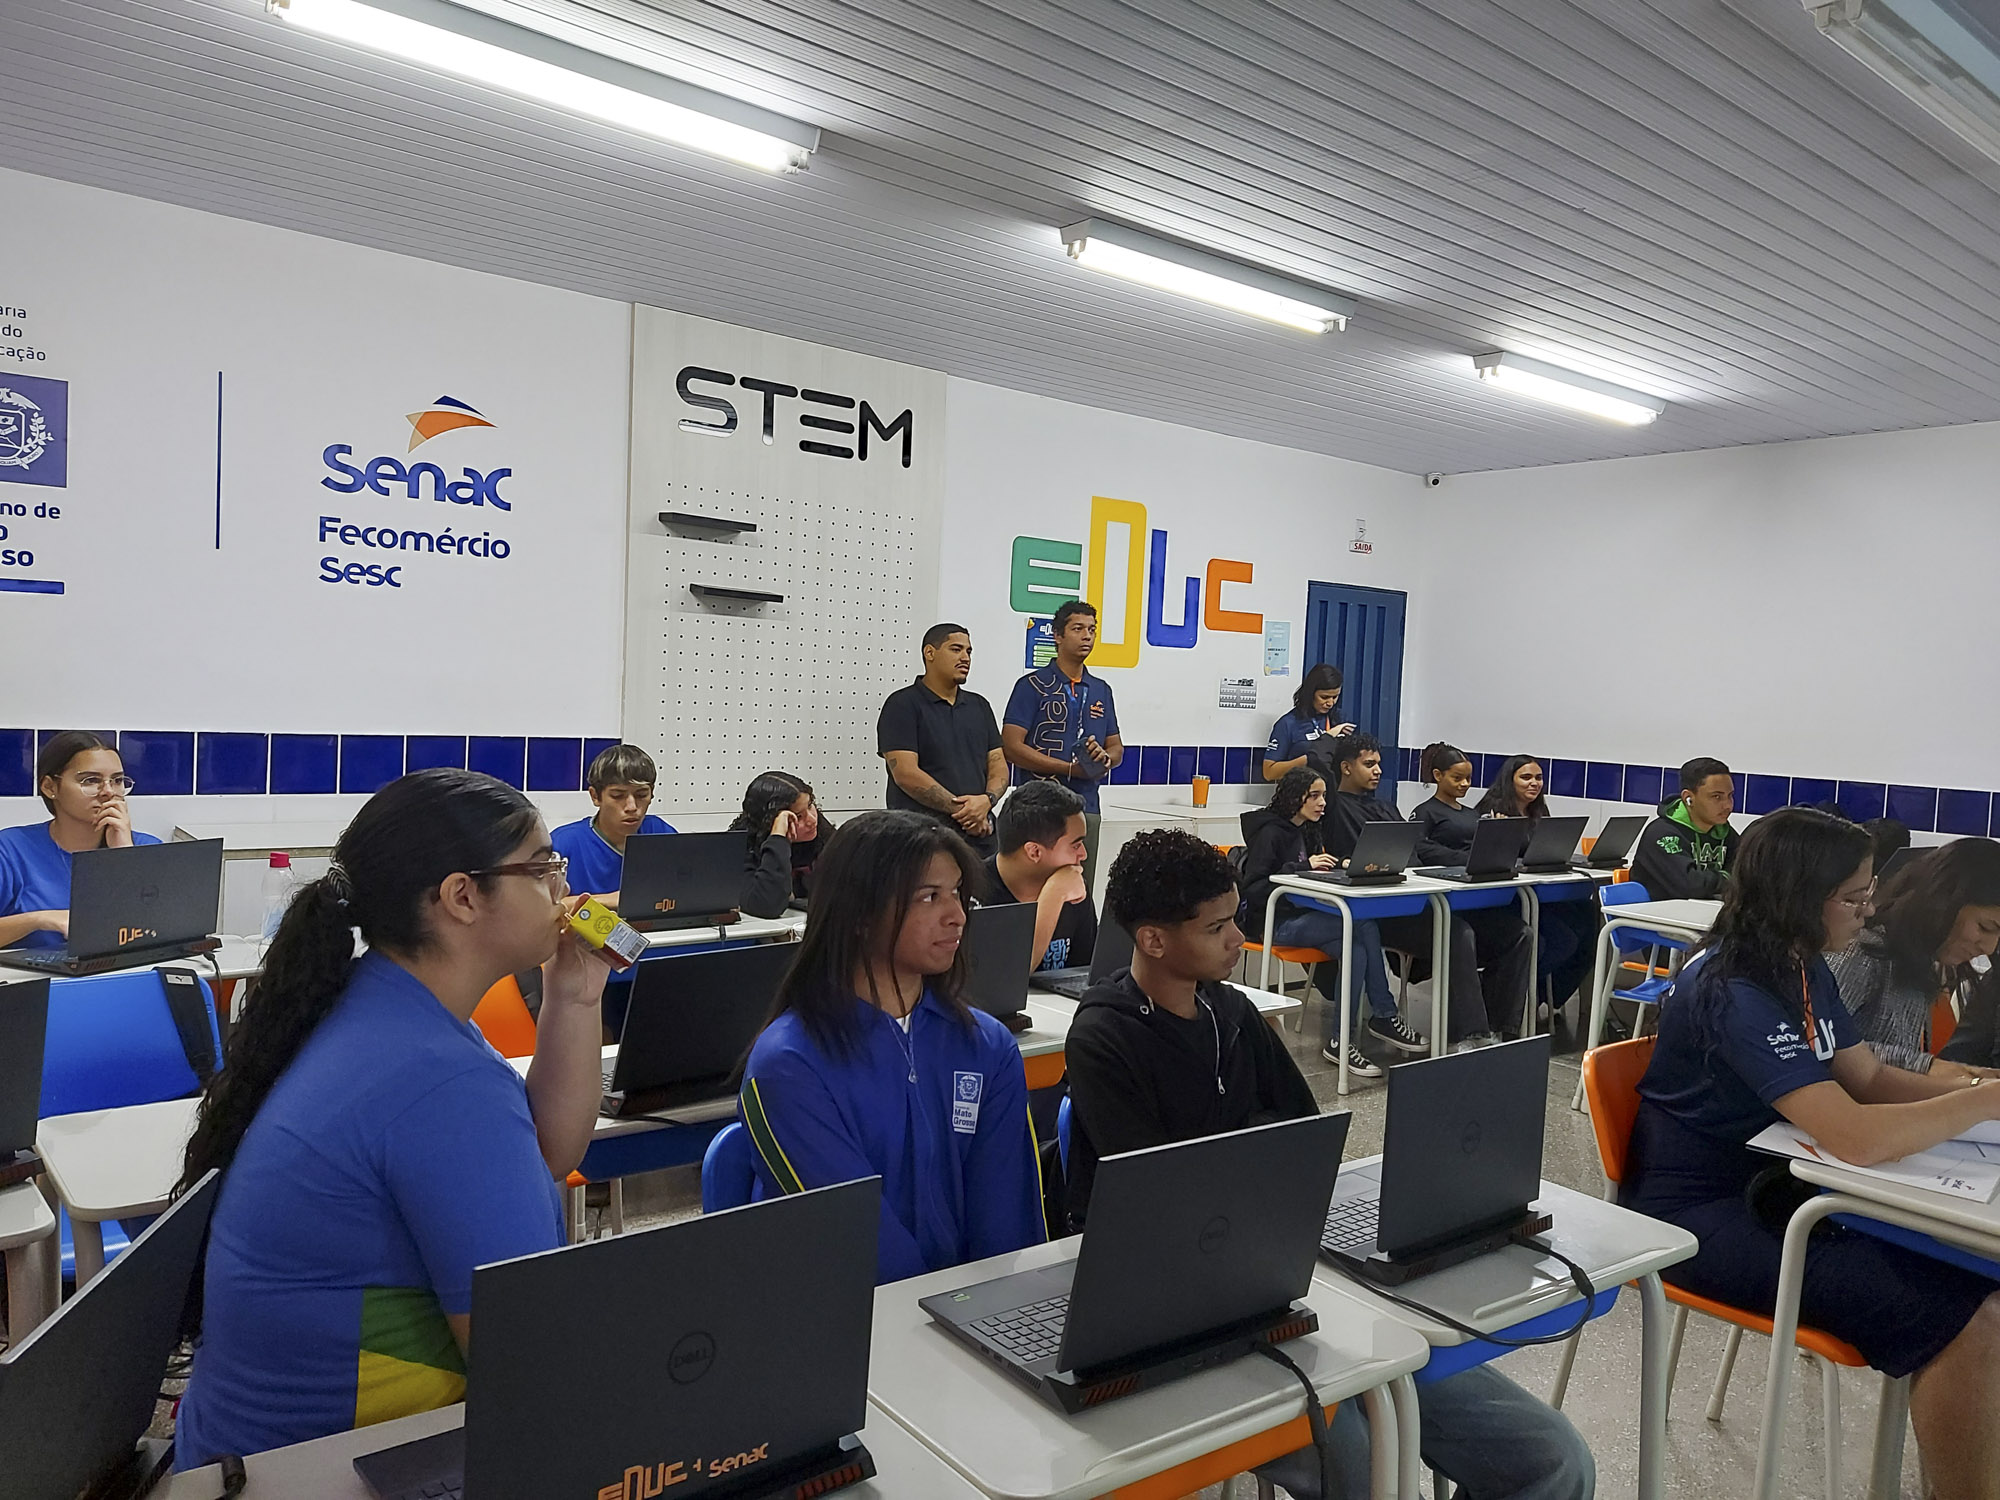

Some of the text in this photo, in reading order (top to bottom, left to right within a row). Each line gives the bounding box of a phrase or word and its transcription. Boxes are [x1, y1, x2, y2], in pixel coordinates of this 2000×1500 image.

[2, 324, 22, 338] do
[676, 365, 913, 469] STEM
[320, 443, 512, 512] Senac
[33, 501, 61, 520] de
[319, 515, 511, 559] Fecomércio
[318, 556, 402, 588] Sesc
[955, 1109, 972, 1117] Mato
